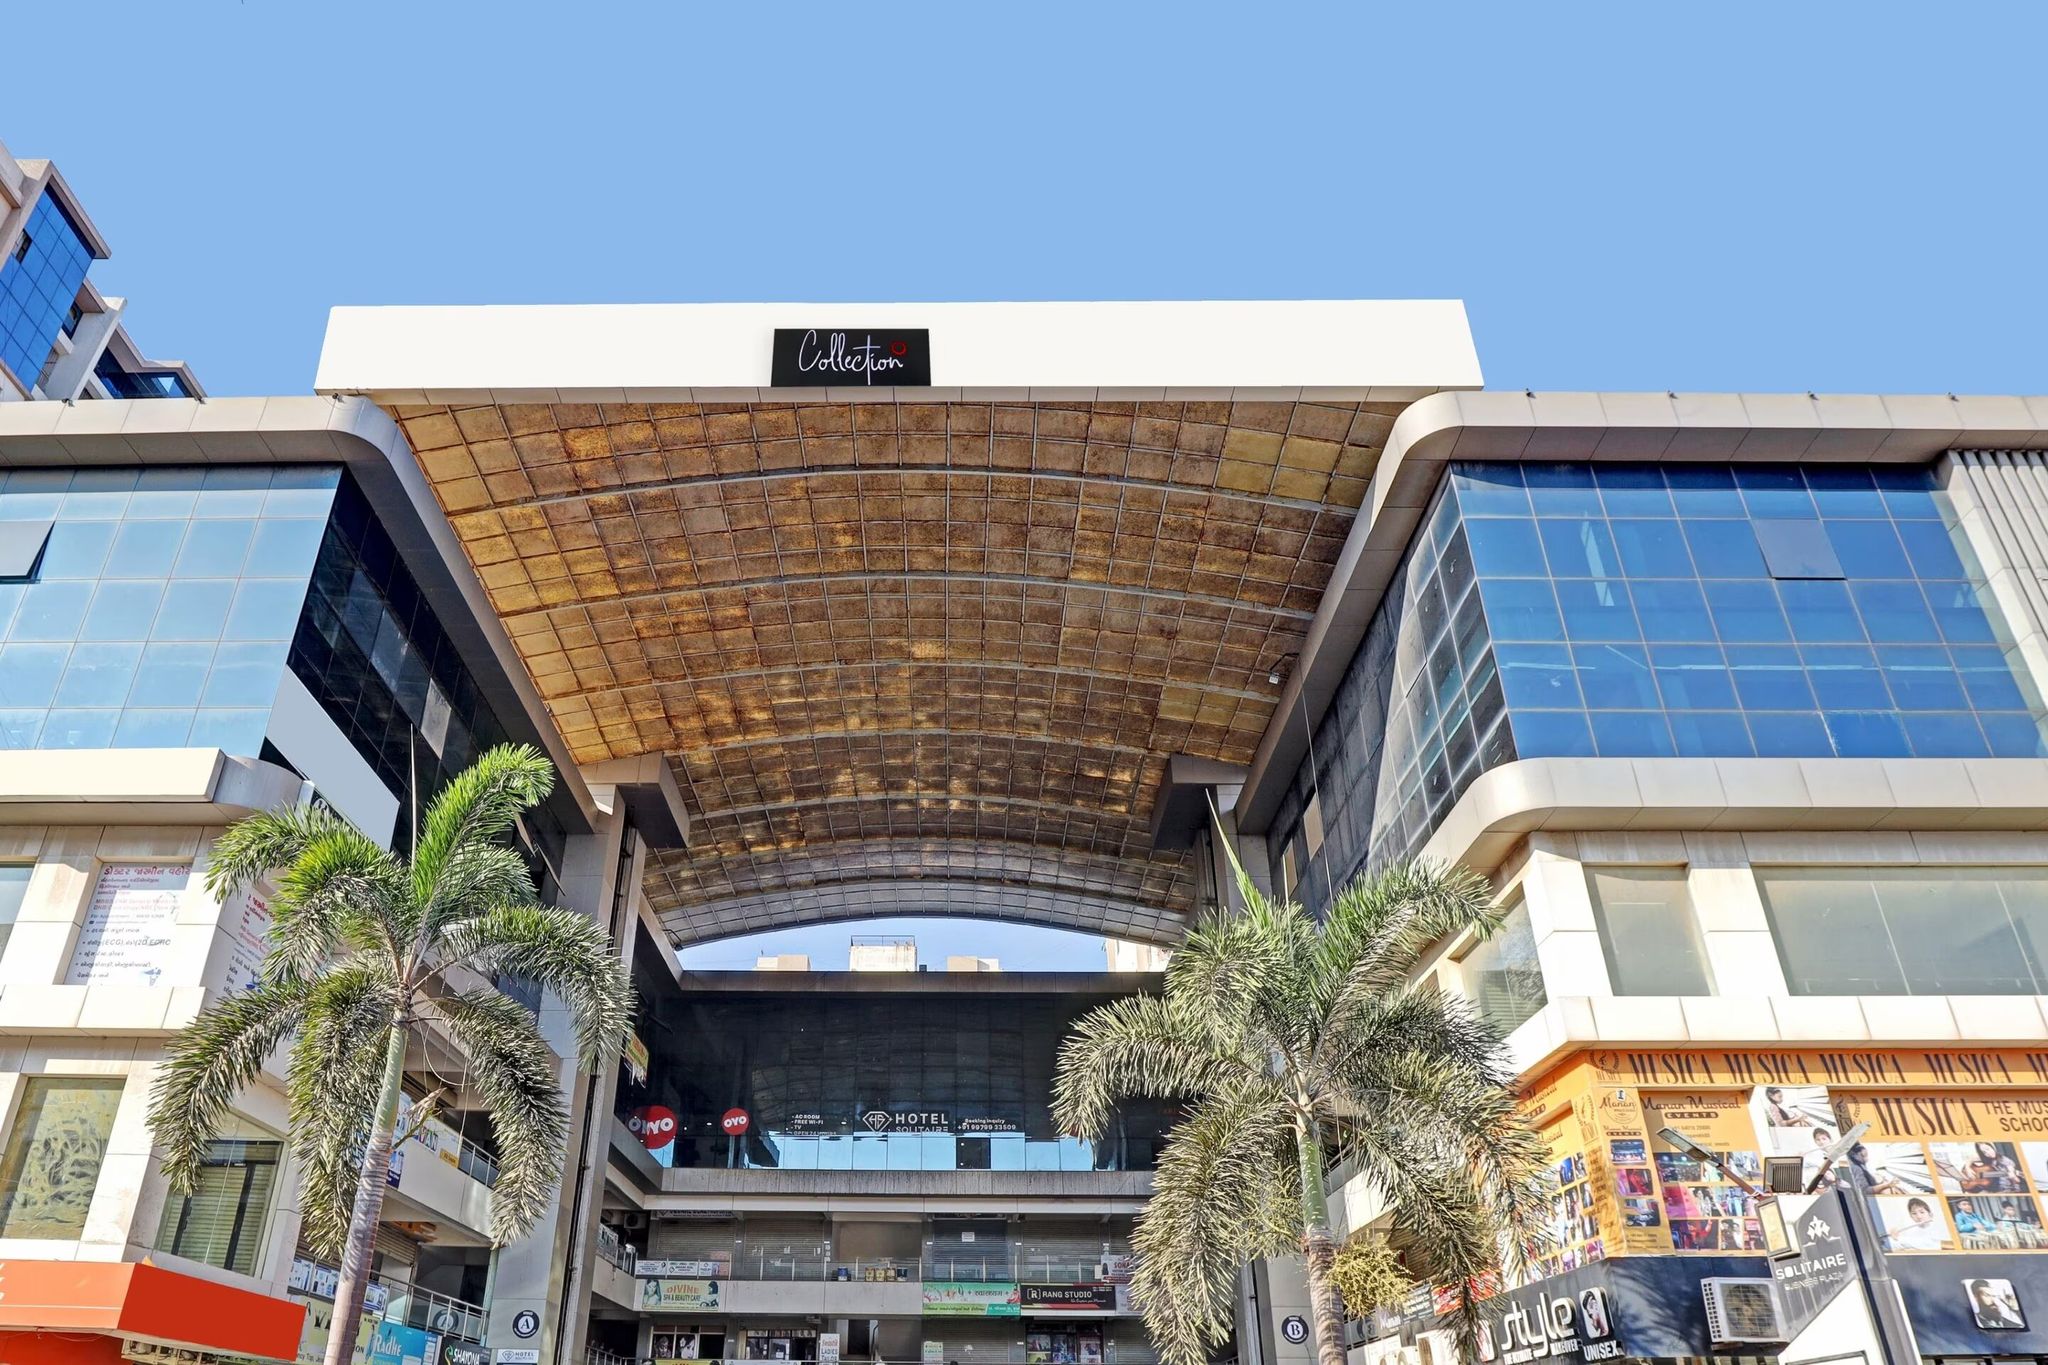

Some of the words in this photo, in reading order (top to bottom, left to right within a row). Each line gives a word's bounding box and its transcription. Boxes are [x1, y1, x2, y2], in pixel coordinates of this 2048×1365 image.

[799, 329, 903, 386] Collection
[1628, 1053, 1715, 1084] MUSICA
[1723, 1053, 1812, 1084] MUSICA
[1818, 1053, 1907, 1084] MUSICA
[1923, 1053, 2013, 1084] MUSICA
[1687, 1095, 1741, 1110] Musical
[1981, 1100, 2013, 1115] THE
[724, 1116, 747, 1127] OYO
[896, 1113, 948, 1124] HOTEL
[1870, 1098, 1981, 1136] MUSICA
[1775, 1253, 1846, 1280] SOLITAIRE
[1042, 1290, 1062, 1298] RANG
[1065, 1290, 1092, 1298] STUDIO
[521, 1318, 530, 1330] A
[1291, 1324, 1300, 1336] B
[1501, 1292, 1574, 1358] style
[1583, 1340, 1619, 1361] UNISEX
